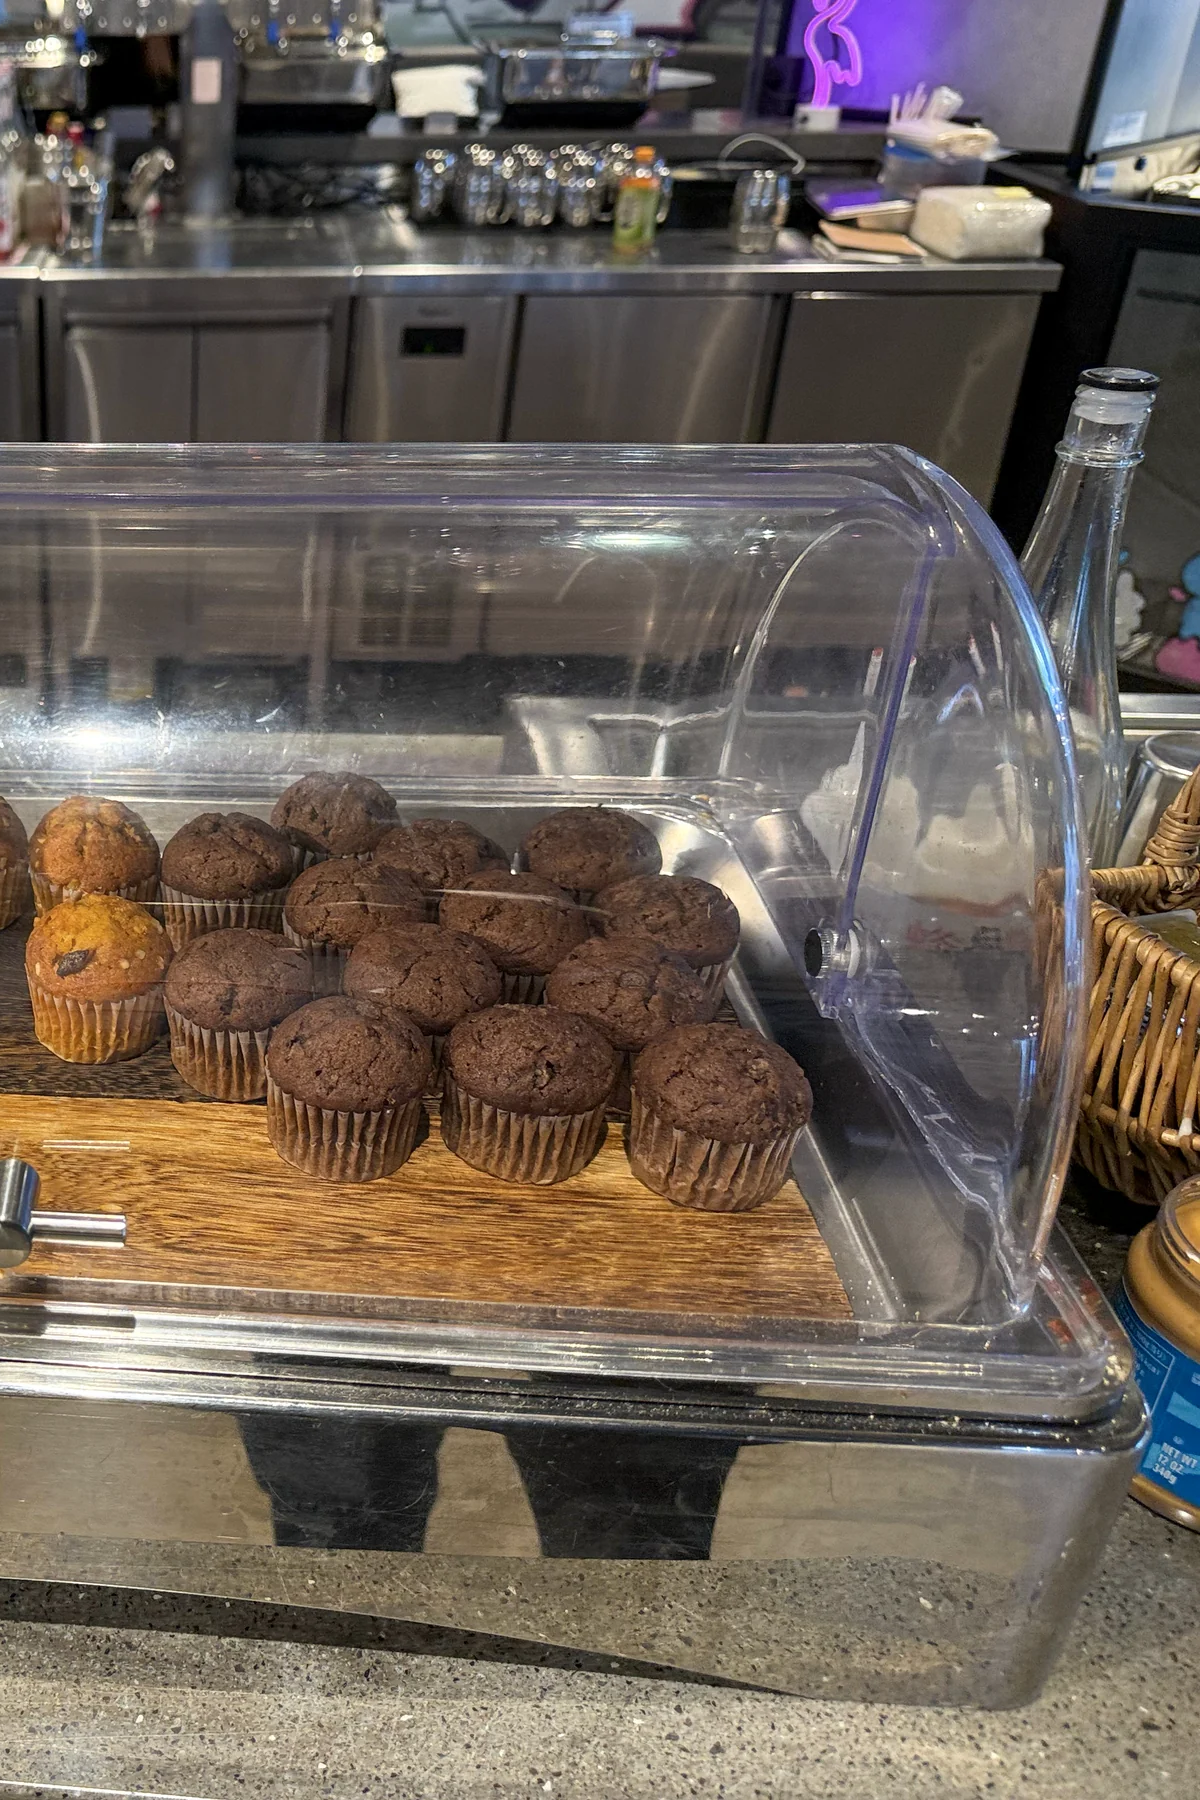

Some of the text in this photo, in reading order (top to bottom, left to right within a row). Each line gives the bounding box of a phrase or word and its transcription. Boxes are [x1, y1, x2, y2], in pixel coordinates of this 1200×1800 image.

[1158, 1453, 1186, 1476] 12 OZ
[1161, 1442, 1198, 1469] NET WT
[1152, 1463, 1178, 1485] 340g
